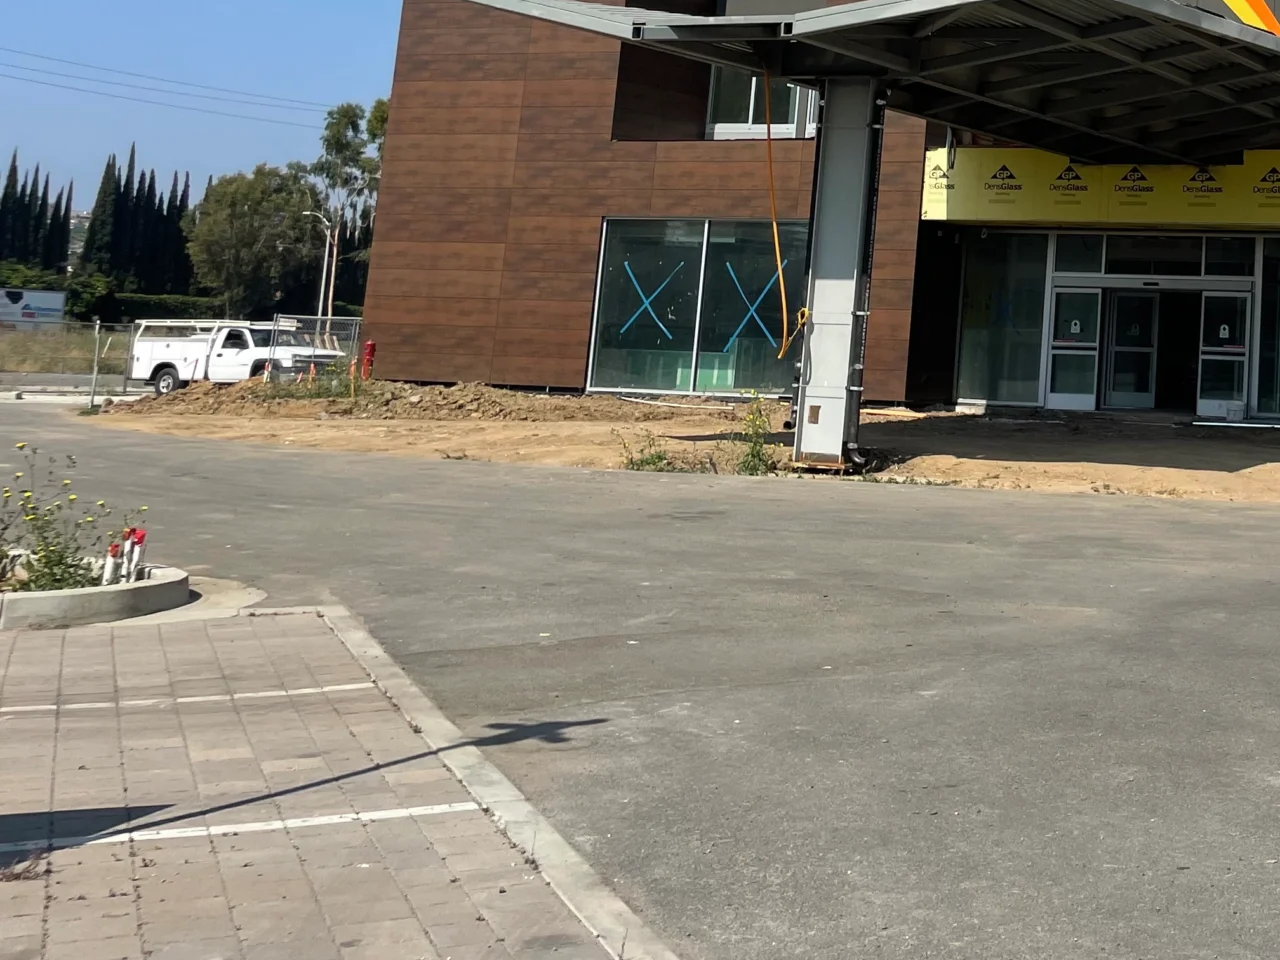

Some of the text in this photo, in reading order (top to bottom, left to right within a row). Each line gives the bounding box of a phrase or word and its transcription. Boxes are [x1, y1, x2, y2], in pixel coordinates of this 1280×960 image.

[996, 170, 1011, 178] GP
[1061, 171, 1076, 179] GP
[1127, 172, 1142, 180] GP
[1195, 172, 1210, 180] GP
[1265, 173, 1280, 181] GP
[984, 182, 1023, 191] DensGlass
[1050, 183, 1088, 191] DensGlass
[1114, 184, 1155, 193] DensGlass
[1182, 185, 1223, 193] DensGlass
